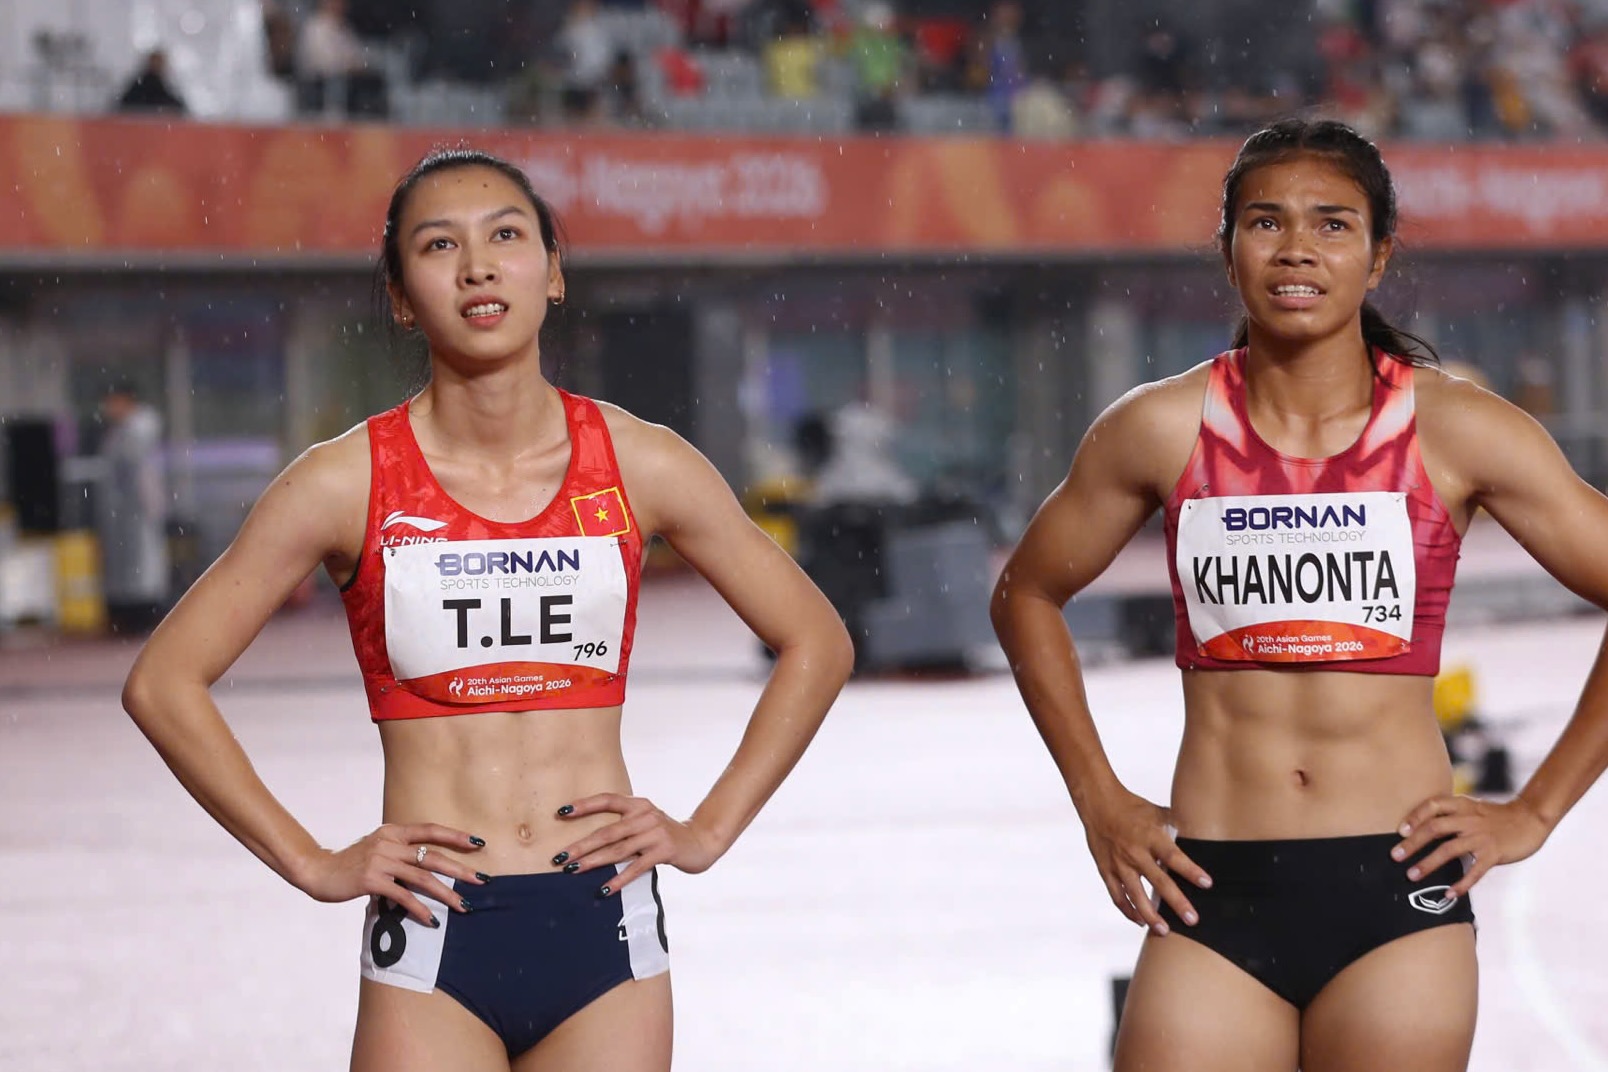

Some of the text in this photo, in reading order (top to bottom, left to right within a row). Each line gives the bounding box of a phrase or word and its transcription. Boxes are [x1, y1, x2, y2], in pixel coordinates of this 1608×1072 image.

[1221, 504, 1366, 531] BORNAN
[1226, 530, 1366, 545] SPORTS TECHNOLOGY
[434, 549, 580, 576] BORNAN
[440, 575, 580, 590] SPORTS TECHNOLOGY
[1193, 550, 1400, 605] KHANONTA
[442, 594, 573, 648] T.LE
[1362, 604, 1402, 623] 734
[1256, 634, 1332, 643] 20th Asian Games
[573, 640, 608, 661] 796
[1257, 641, 1364, 656] Aichi-Nagoya 2026
[467, 674, 544, 686] 20th Asian Games
[467, 678, 572, 697] Aichi-Nagoya 2026
